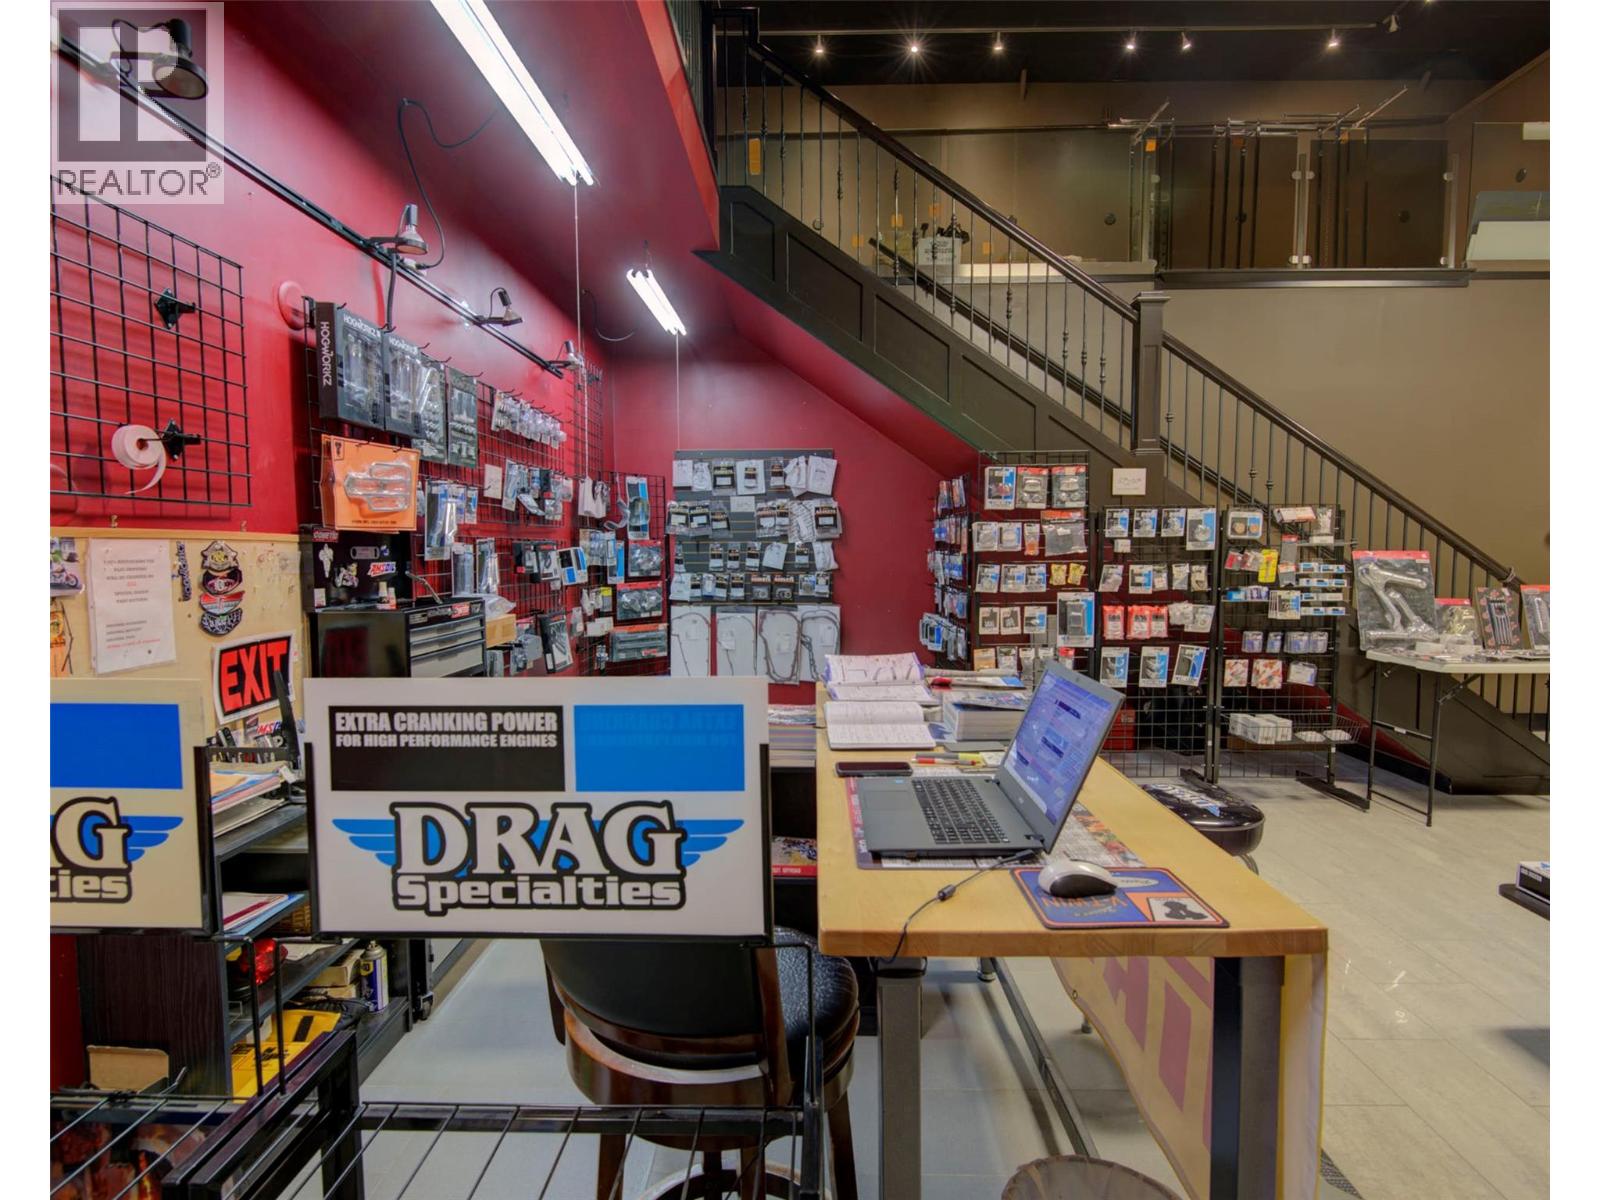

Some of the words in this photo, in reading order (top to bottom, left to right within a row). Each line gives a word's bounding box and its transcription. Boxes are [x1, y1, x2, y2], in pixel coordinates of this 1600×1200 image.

[320, 321, 333, 387] HOGWORKZ
[220, 640, 288, 713] EXIT
[335, 712, 391, 732] EXTRA
[394, 712, 488, 732] CRANKING
[491, 712, 558, 732] POWER
[335, 734, 362, 747] FOR
[364, 734, 397, 747] HIGH
[400, 734, 498, 747] PERFORMANCE
[500, 734, 557, 747] ENGINES
[390, 801, 687, 875] DRAG
[394, 873, 686, 916] Specialties
